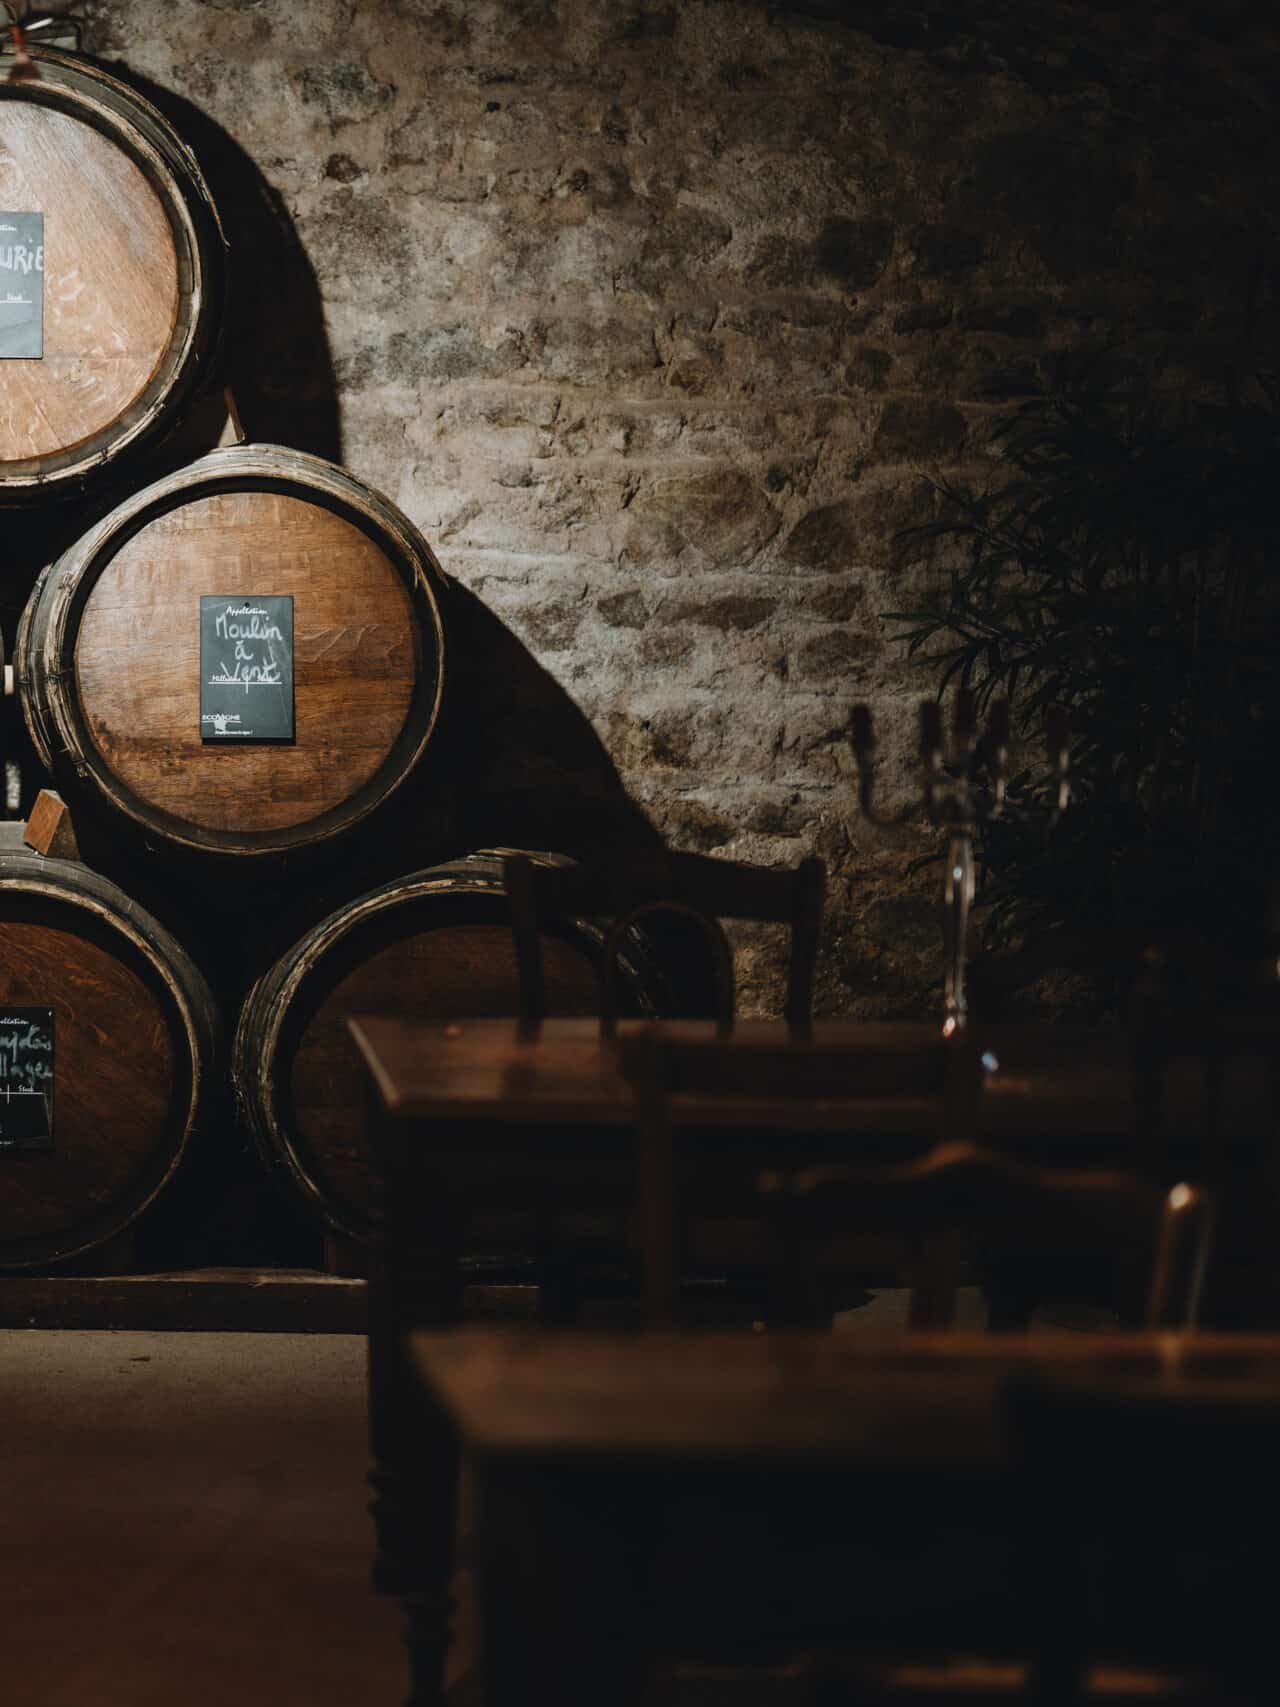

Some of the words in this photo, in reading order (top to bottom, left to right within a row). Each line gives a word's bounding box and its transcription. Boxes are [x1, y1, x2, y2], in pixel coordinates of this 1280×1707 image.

[226, 605, 268, 616] Appellation
[215, 613, 283, 641] Moulin
[220, 656, 281, 683] Vent
